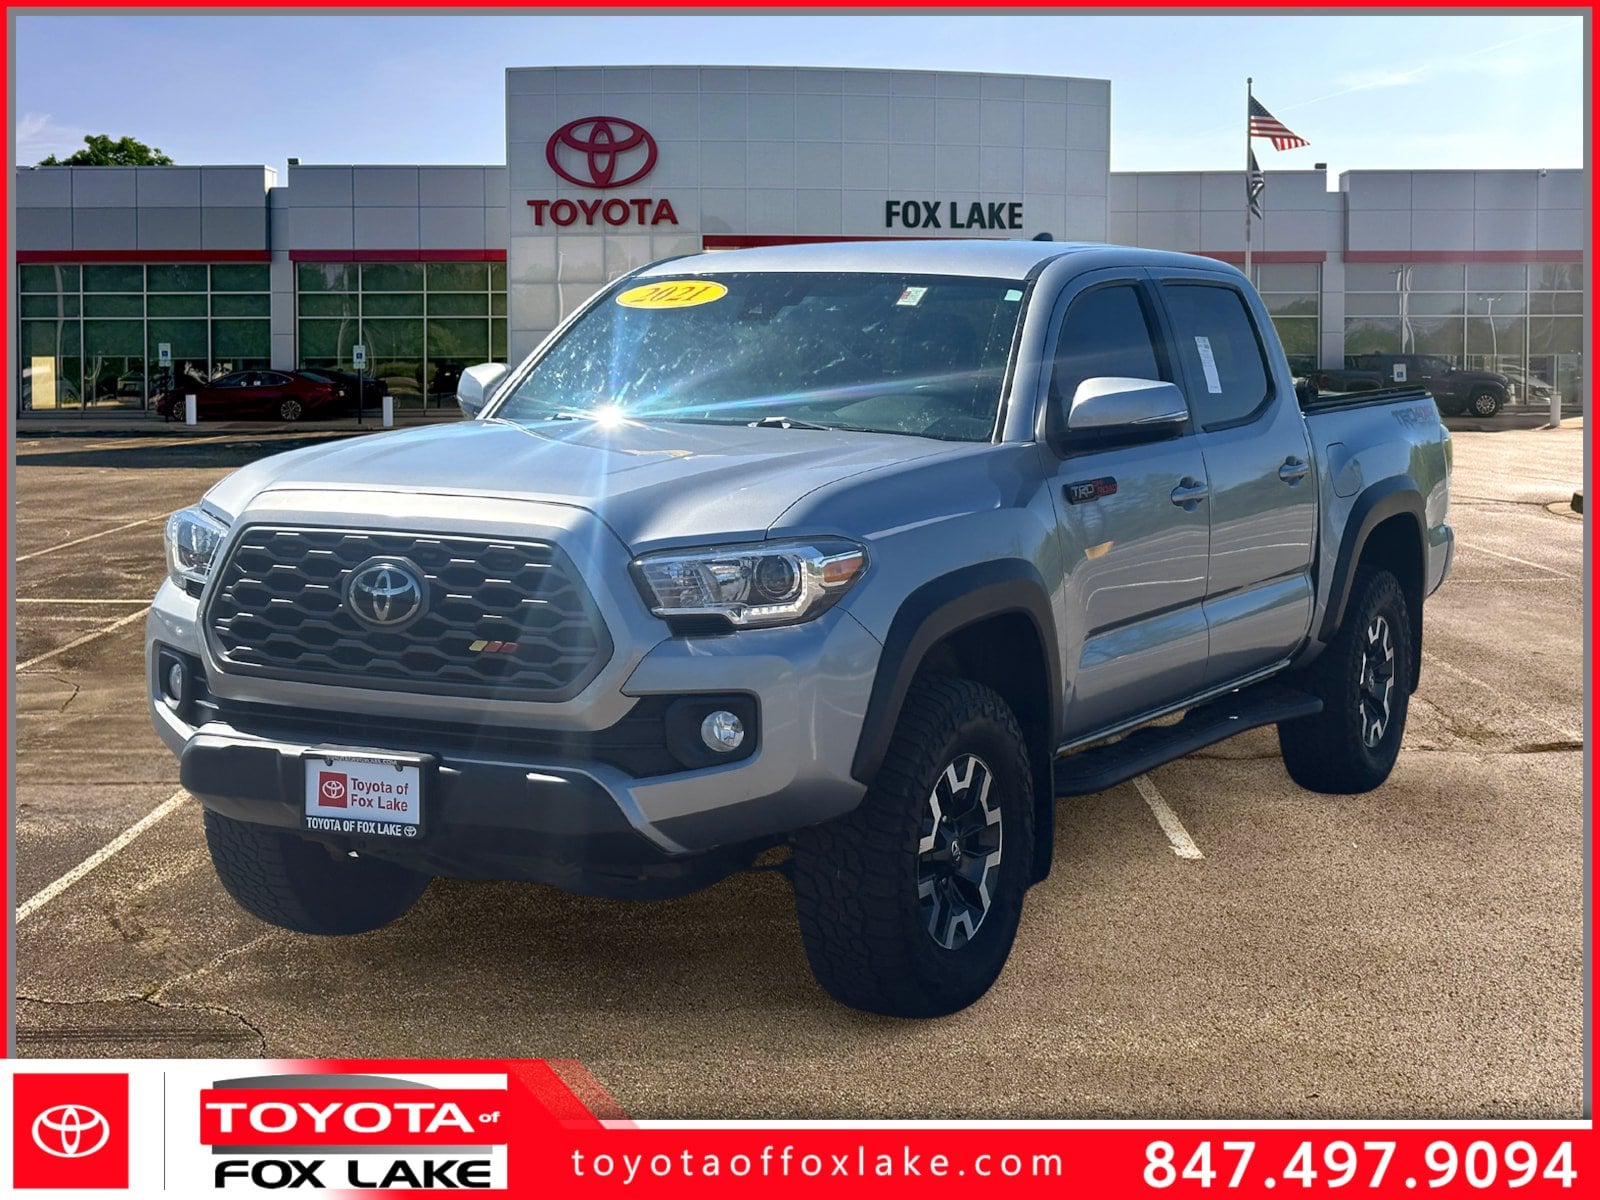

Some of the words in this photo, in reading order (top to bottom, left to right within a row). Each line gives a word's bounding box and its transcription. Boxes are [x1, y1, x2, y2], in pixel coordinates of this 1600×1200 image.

[527, 199, 679, 226] TOYOTA
[885, 200, 942, 229] FOX
[949, 201, 1023, 230] LAKE
[630, 286, 712, 303] 2021
[1070, 483, 1095, 499] TRD
[350, 778, 392, 795] Toyota
[396, 783, 409, 796] of
[351, 793, 374, 809] Fox
[377, 796, 408, 812] Lake
[306, 816, 341, 832] TOYOTA
[343, 820, 356, 833] OF
[357, 821, 376, 835] FOX
[377, 823, 402, 837] LAKE
